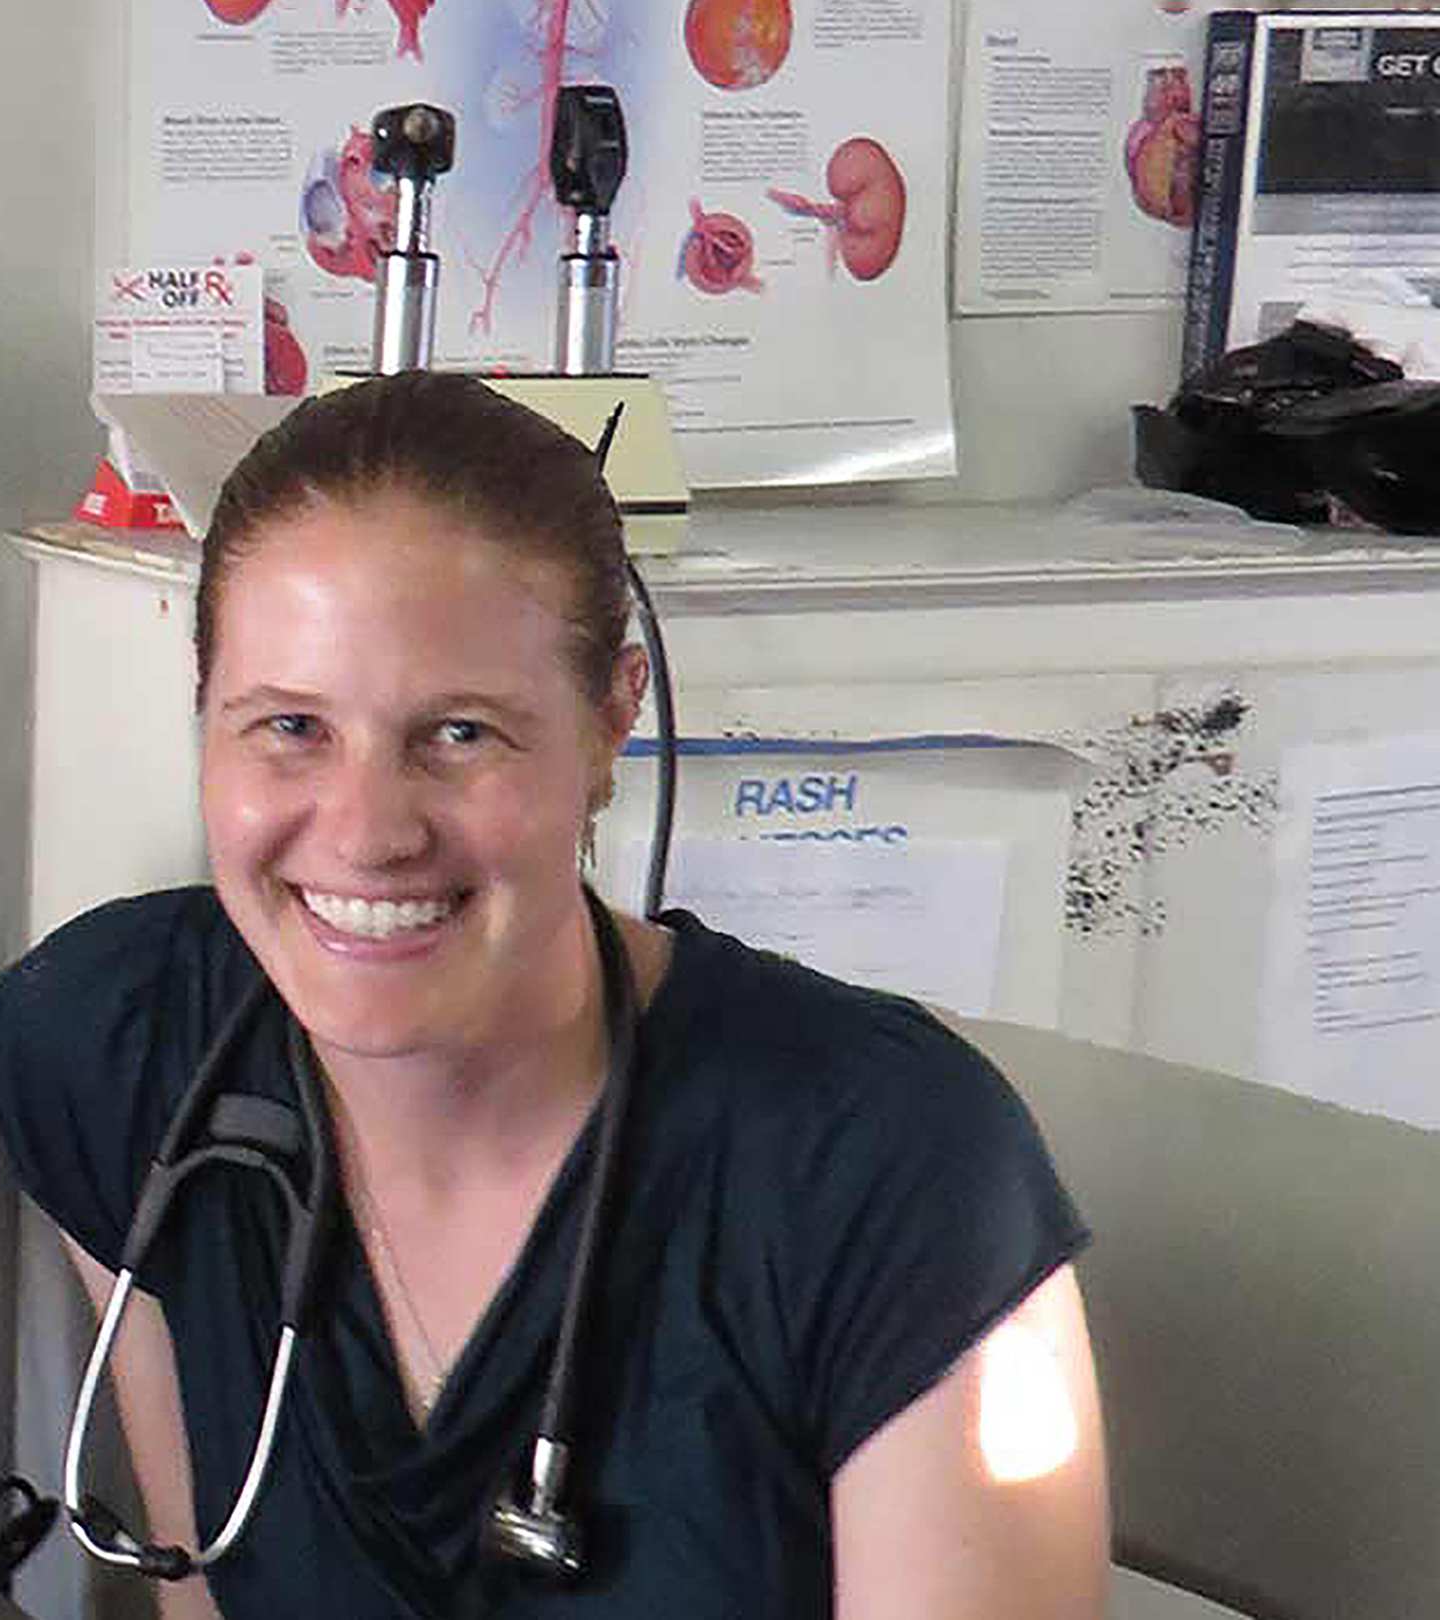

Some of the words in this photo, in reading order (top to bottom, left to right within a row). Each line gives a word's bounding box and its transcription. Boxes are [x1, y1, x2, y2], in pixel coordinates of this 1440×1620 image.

[1377, 53, 1429, 77] GET
[148, 271, 199, 289] HALF
[161, 290, 200, 308] OFF
[735, 774, 858, 817] RASH
